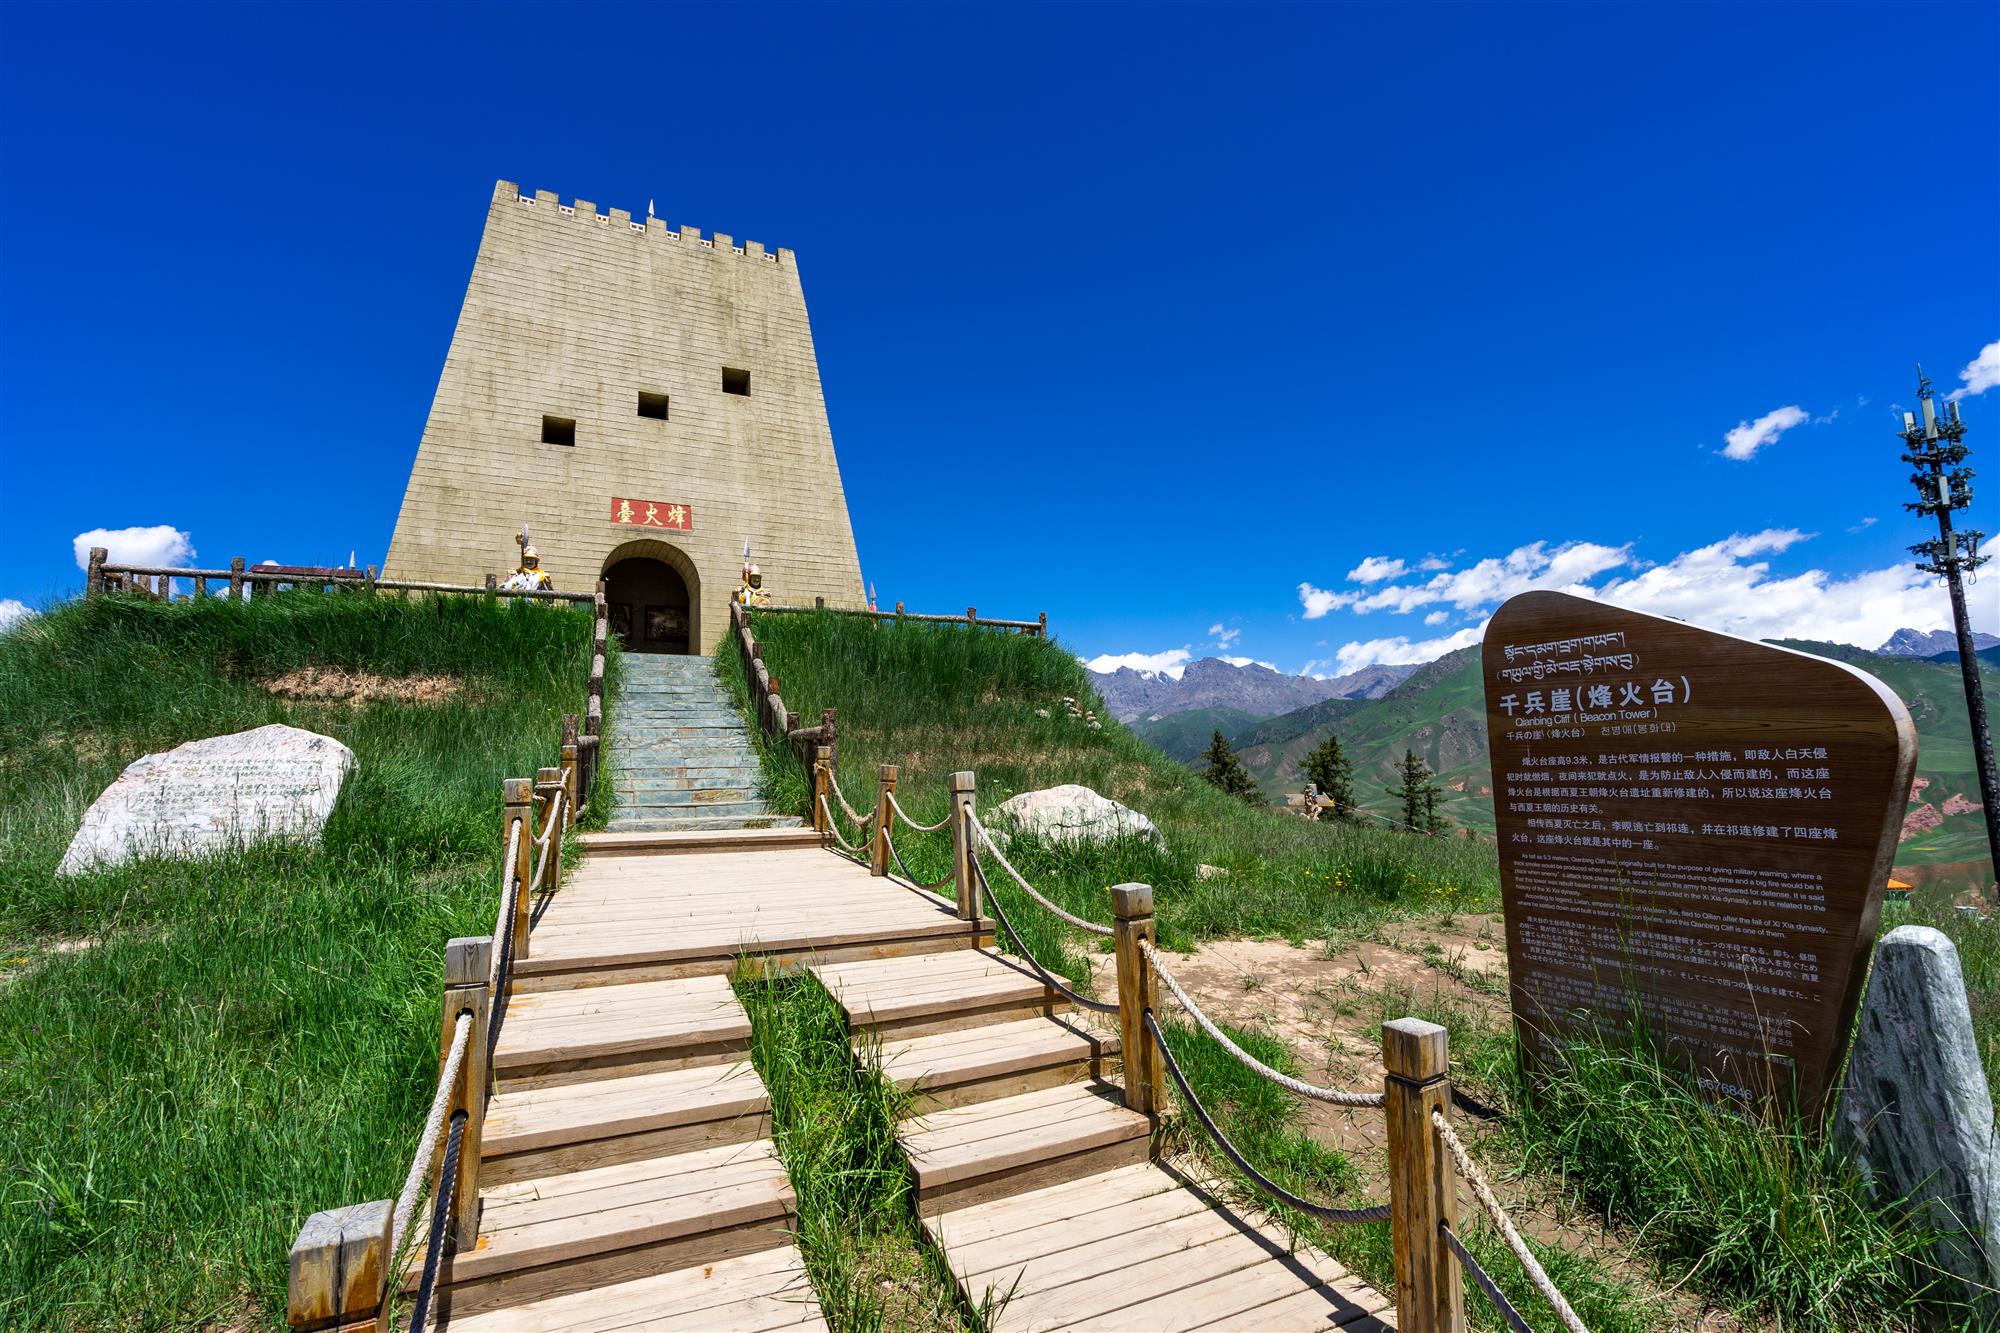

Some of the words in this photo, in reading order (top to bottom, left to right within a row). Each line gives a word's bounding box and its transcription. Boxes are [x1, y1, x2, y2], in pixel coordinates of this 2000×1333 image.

[1499, 675, 1691, 717] 千兵崖(烽火台)
[1515, 717, 1553, 728] Qianbing
[1553, 714, 1571, 724] Cliff
[1791, 872, 1815, 880] where
[1781, 881, 1803, 889] would
[1808, 894, 1825, 902] said
[1777, 901, 1802, 910] related
[1796, 923, 1829, 934] dynasty,
